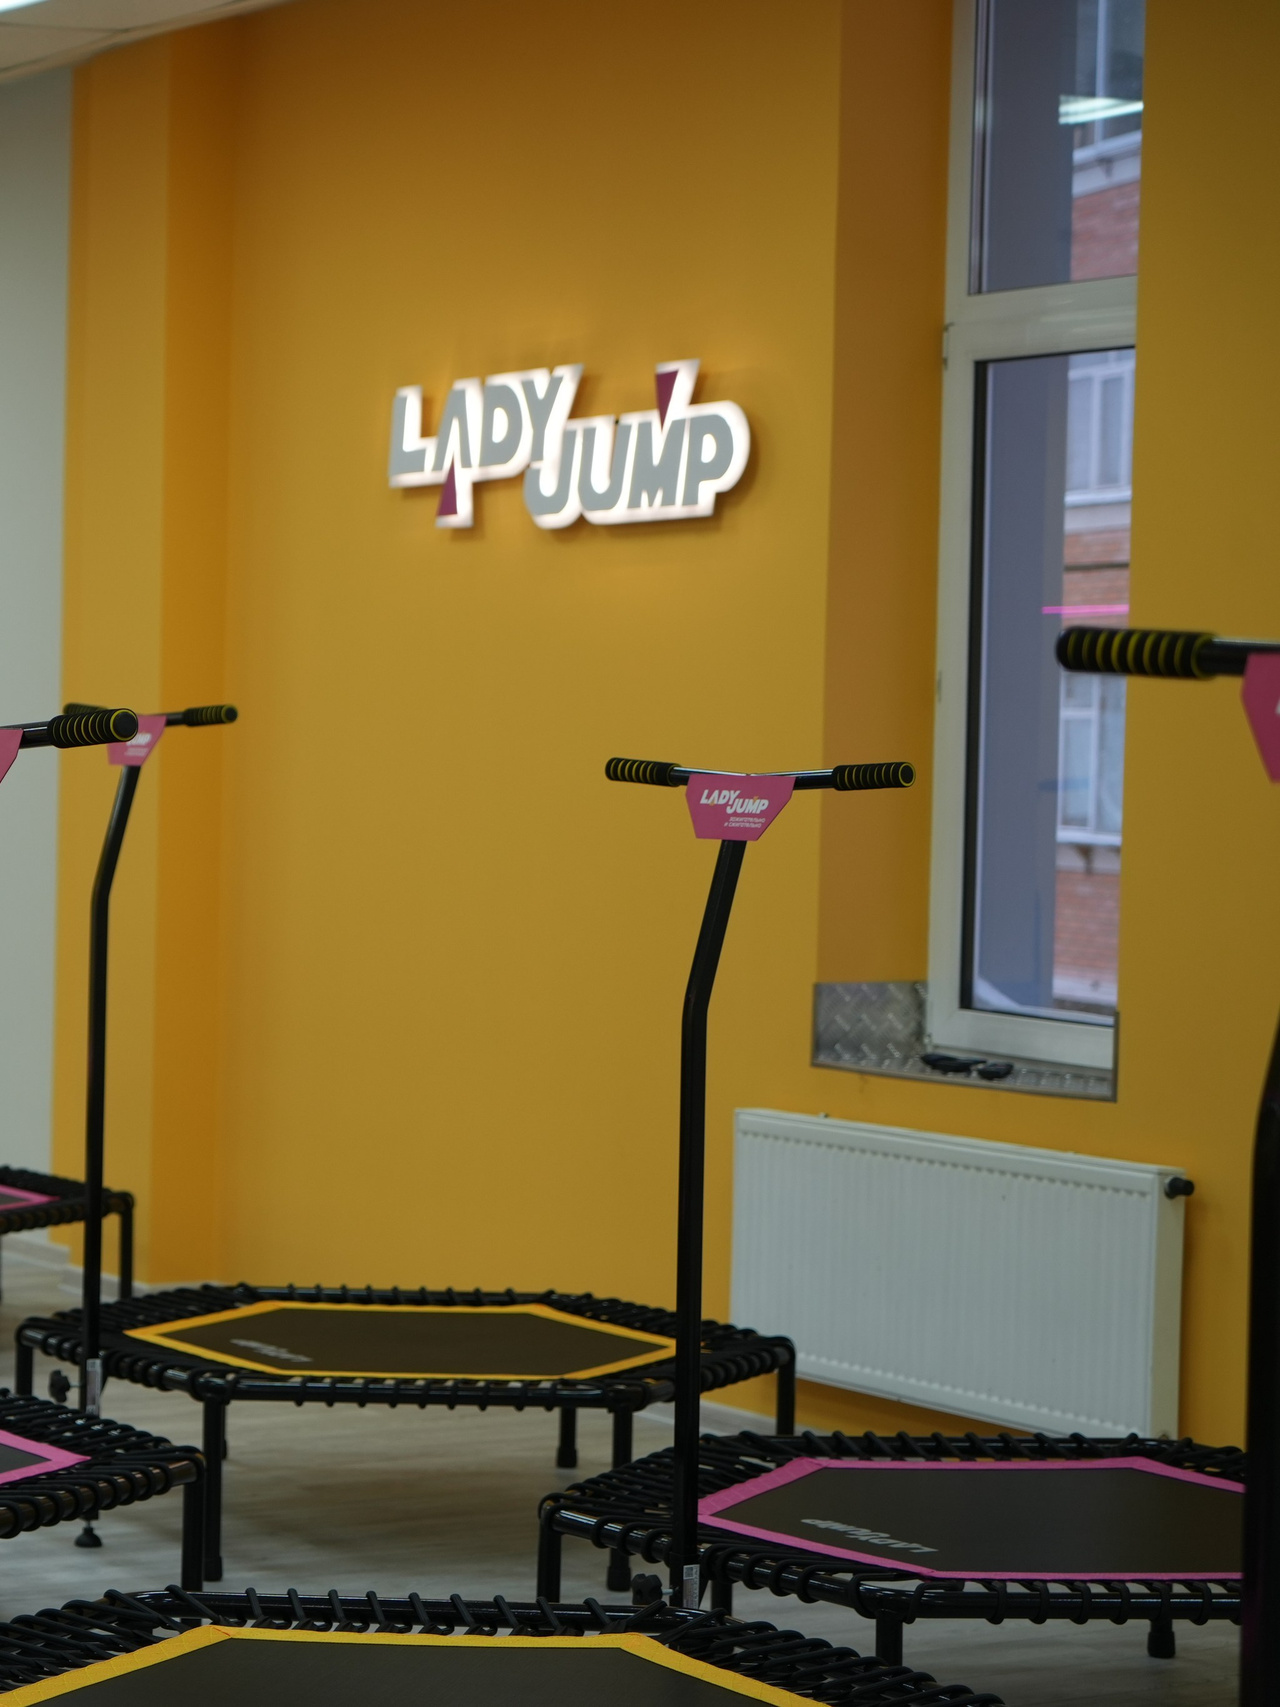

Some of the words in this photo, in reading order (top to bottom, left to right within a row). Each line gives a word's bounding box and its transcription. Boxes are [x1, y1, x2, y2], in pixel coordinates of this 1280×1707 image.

[389, 363, 584, 527] LADY
[523, 358, 751, 529] JUMP
[700, 789, 741, 806] LADY
[726, 796, 769, 814] JUMP
